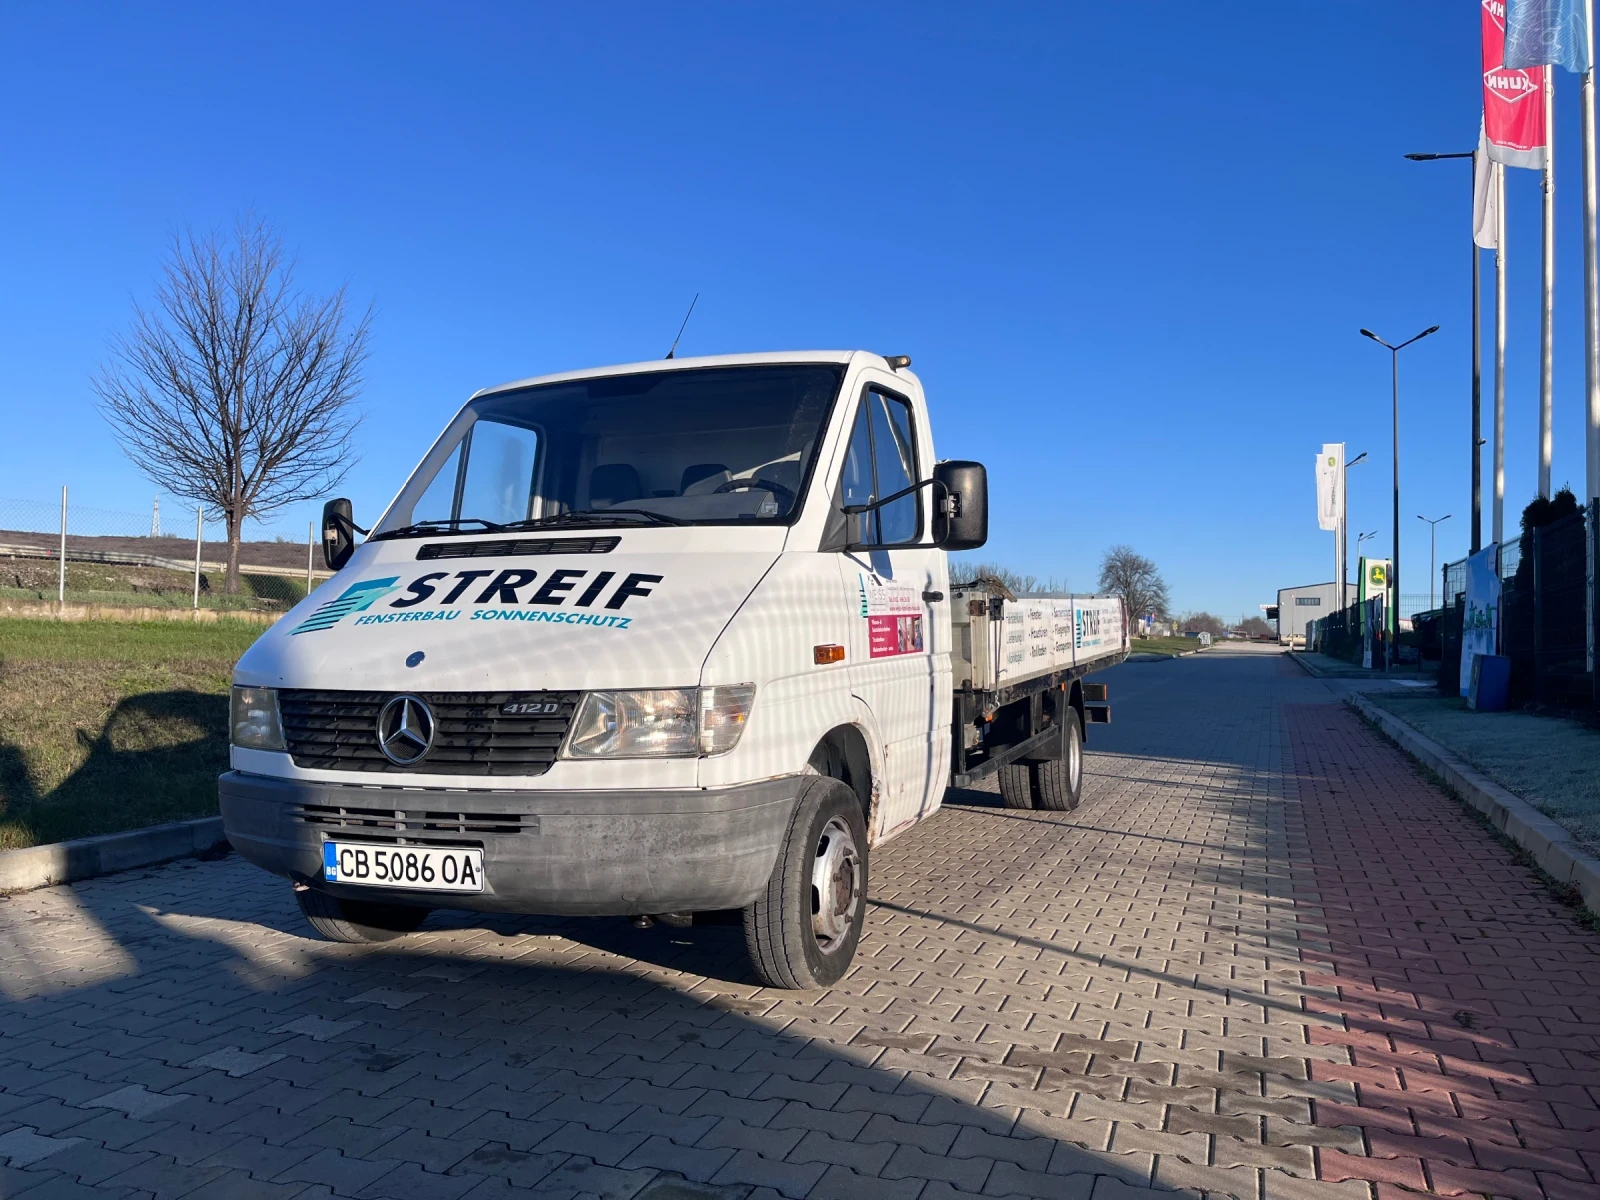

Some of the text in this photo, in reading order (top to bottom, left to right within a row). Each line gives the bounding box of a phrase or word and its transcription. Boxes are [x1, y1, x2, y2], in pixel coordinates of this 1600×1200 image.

[389, 569, 664, 610] STREIF
[354, 609, 633, 629] FENSTERBAU SONNENSCHUTZ
[326, 866, 337, 876] BG
[340, 849, 477, 885] CB 5086 OA
